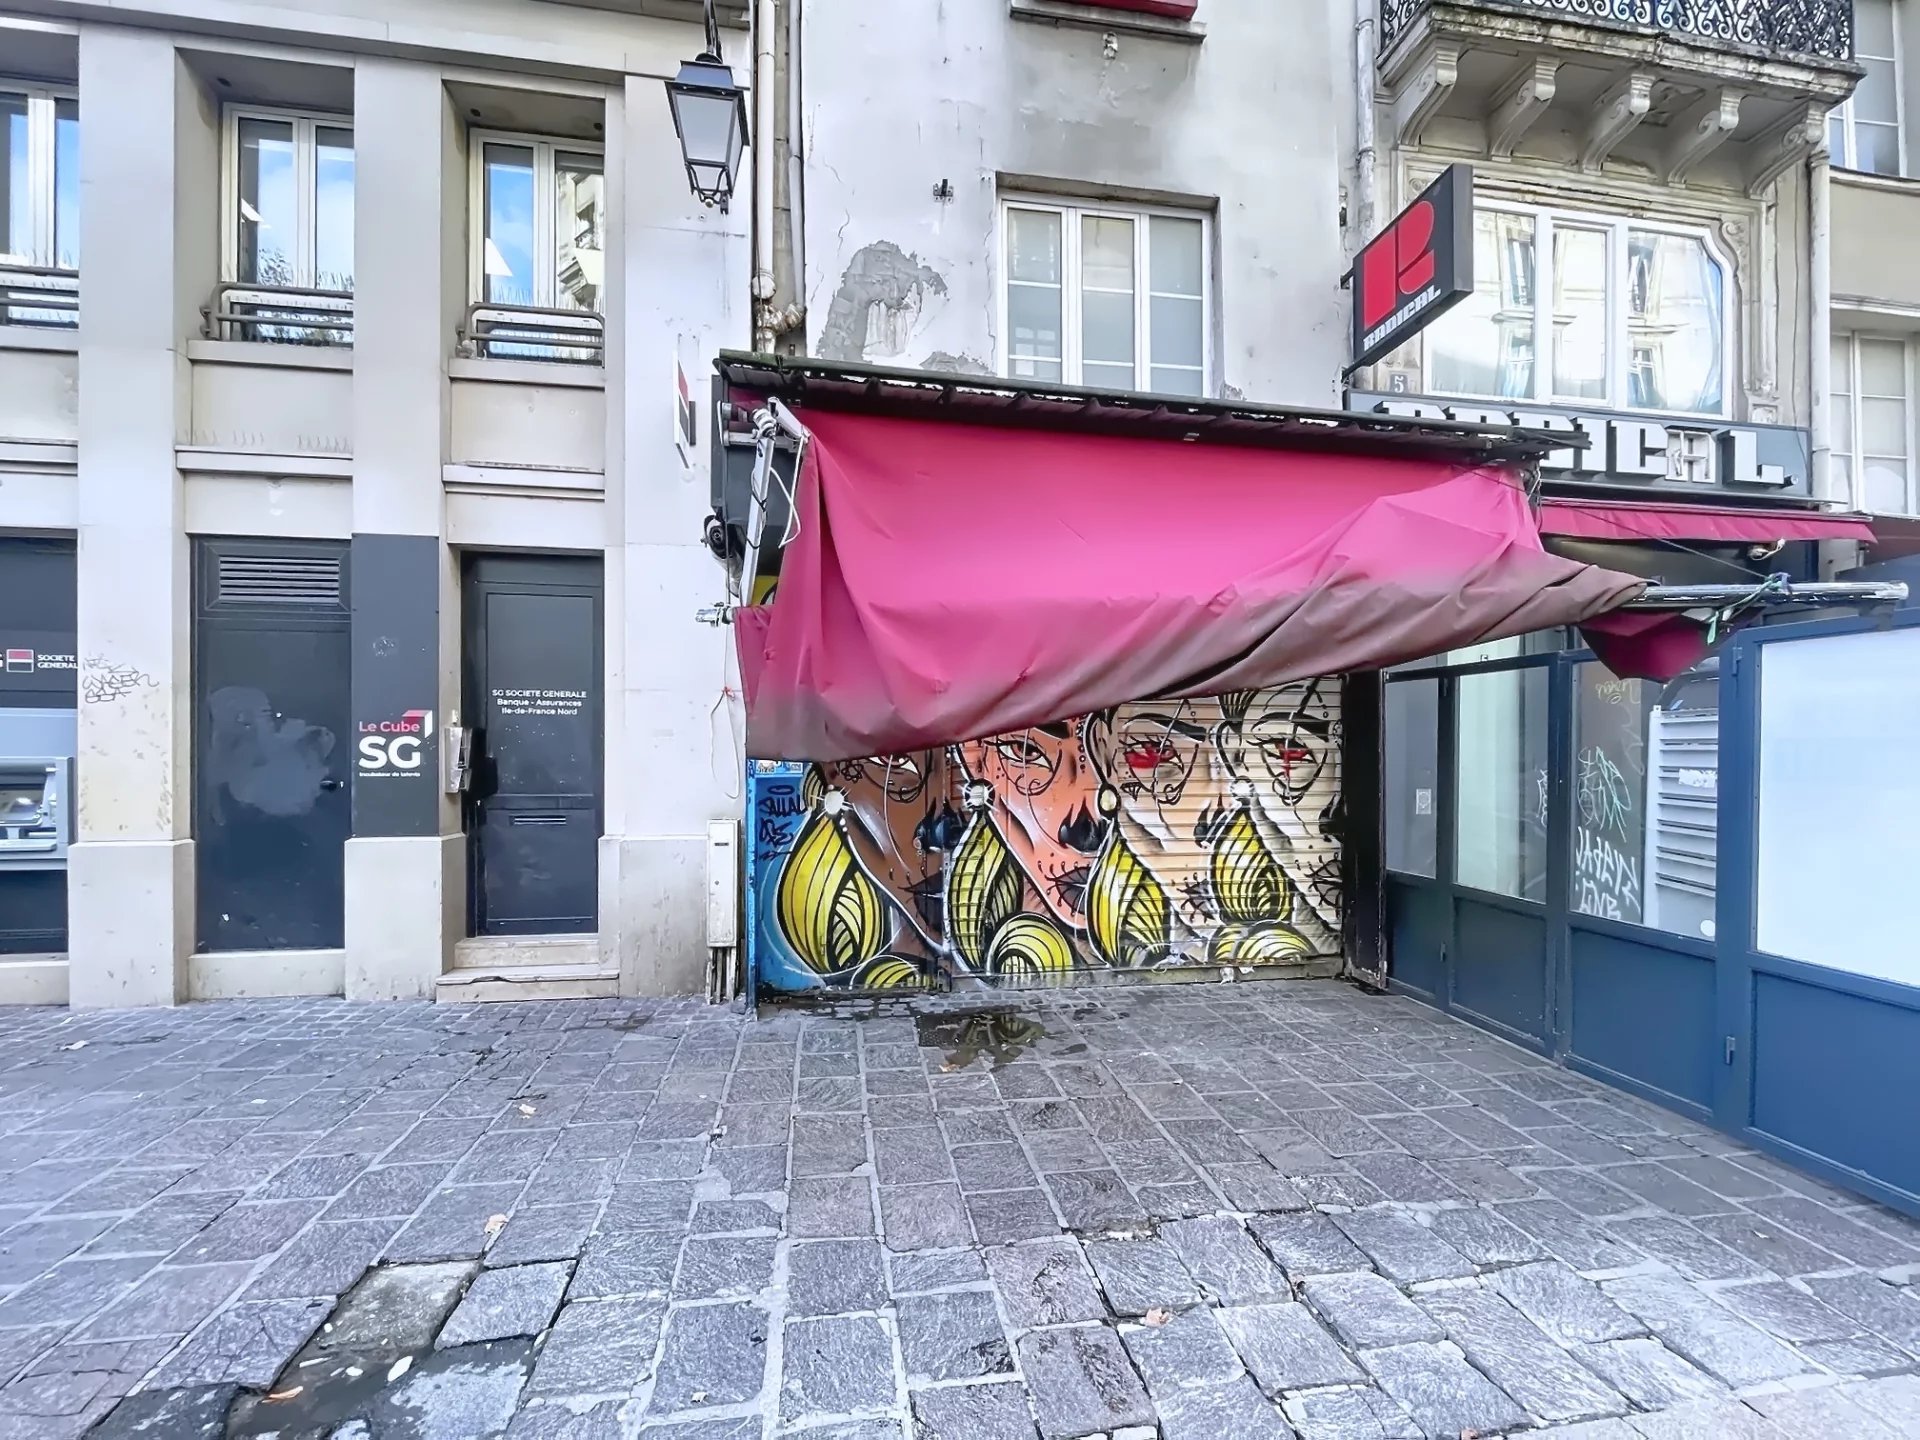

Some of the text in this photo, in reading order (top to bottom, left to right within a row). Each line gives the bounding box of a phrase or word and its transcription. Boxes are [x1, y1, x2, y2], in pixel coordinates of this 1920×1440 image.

[1362, 284, 1442, 352] RADICAL
[1394, 375, 1404, 393] 5
[1376, 400, 1785, 486] DICAL
[37, 654, 75, 662] SOCIETE
[491, 689, 587, 698] SG SOCIETE GENERALE
[497, 698, 529, 706] Banque
[535, 699, 582, 707] Assurances
[359, 720, 421, 732] Le Cube
[358, 735, 421, 769] SG
